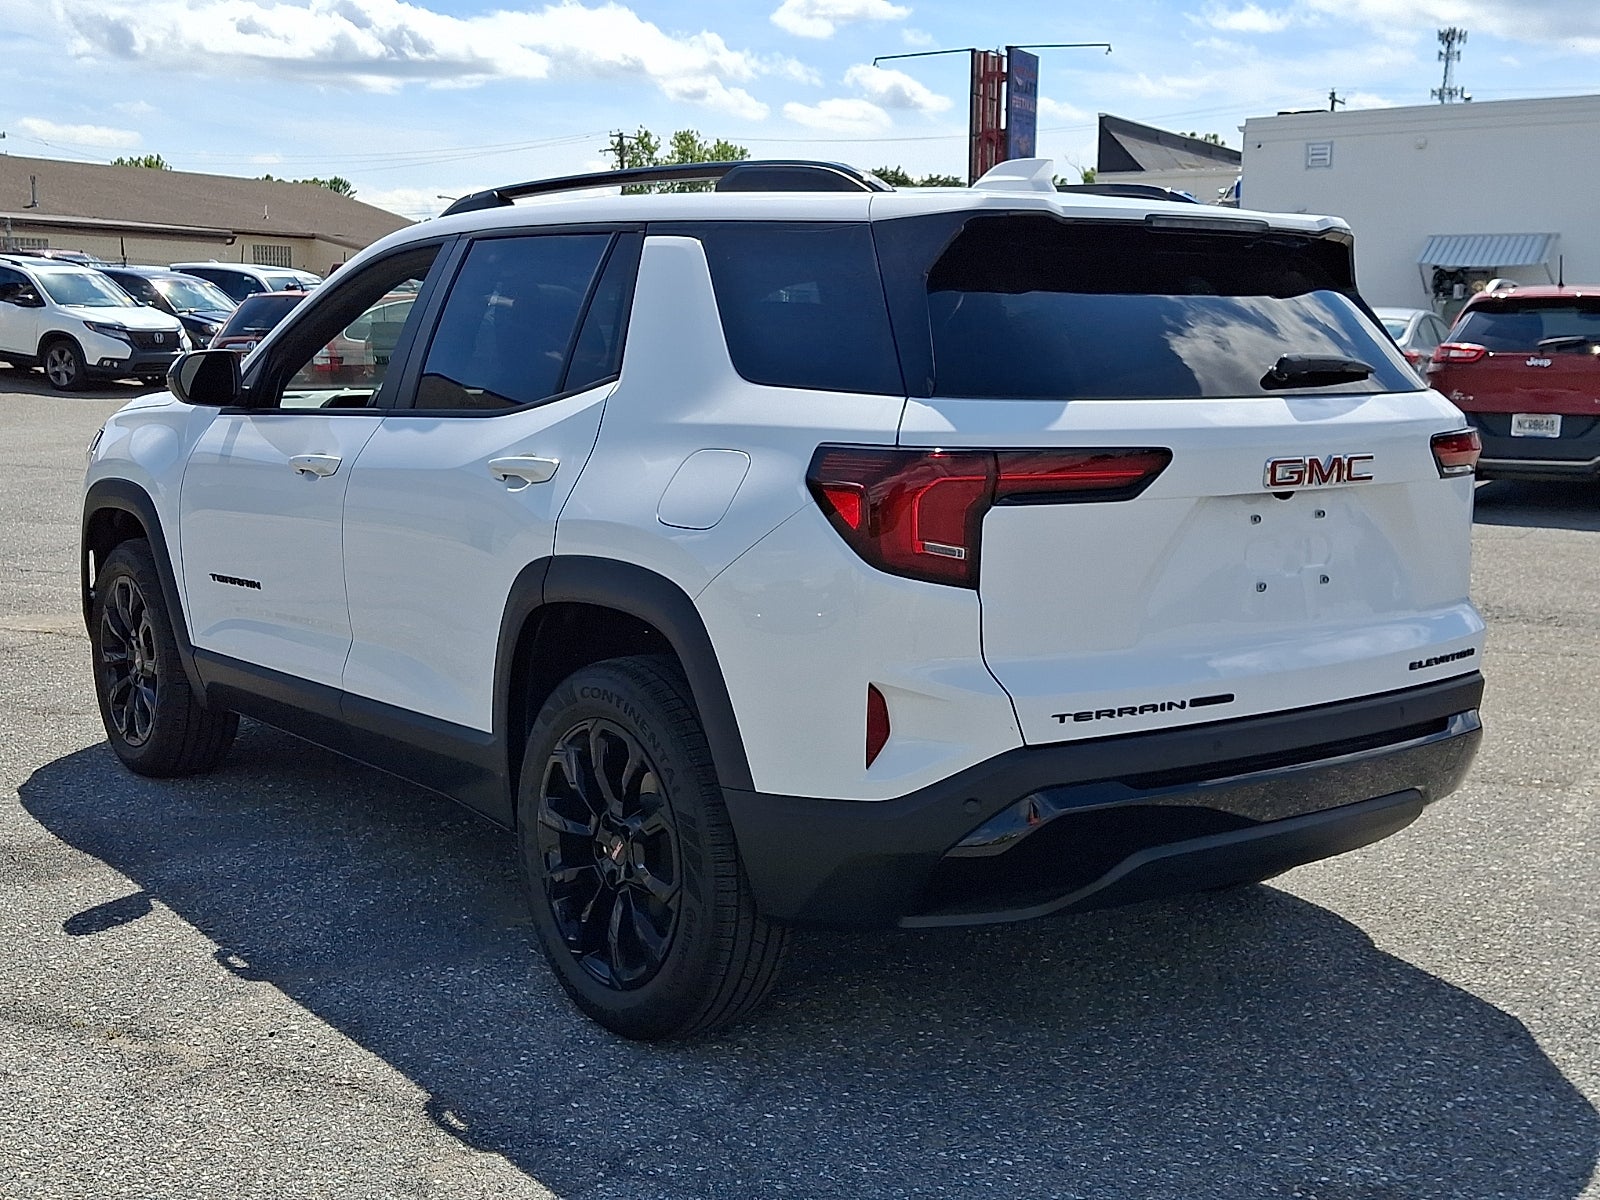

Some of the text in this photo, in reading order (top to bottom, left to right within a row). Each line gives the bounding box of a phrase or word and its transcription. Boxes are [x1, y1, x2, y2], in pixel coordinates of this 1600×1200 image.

[1264, 452, 1375, 488] GMC
[209, 573, 262, 590] TERRAIN
[1408, 647, 1476, 671] ELEVATION
[1051, 699, 1187, 724] TERRAIN
